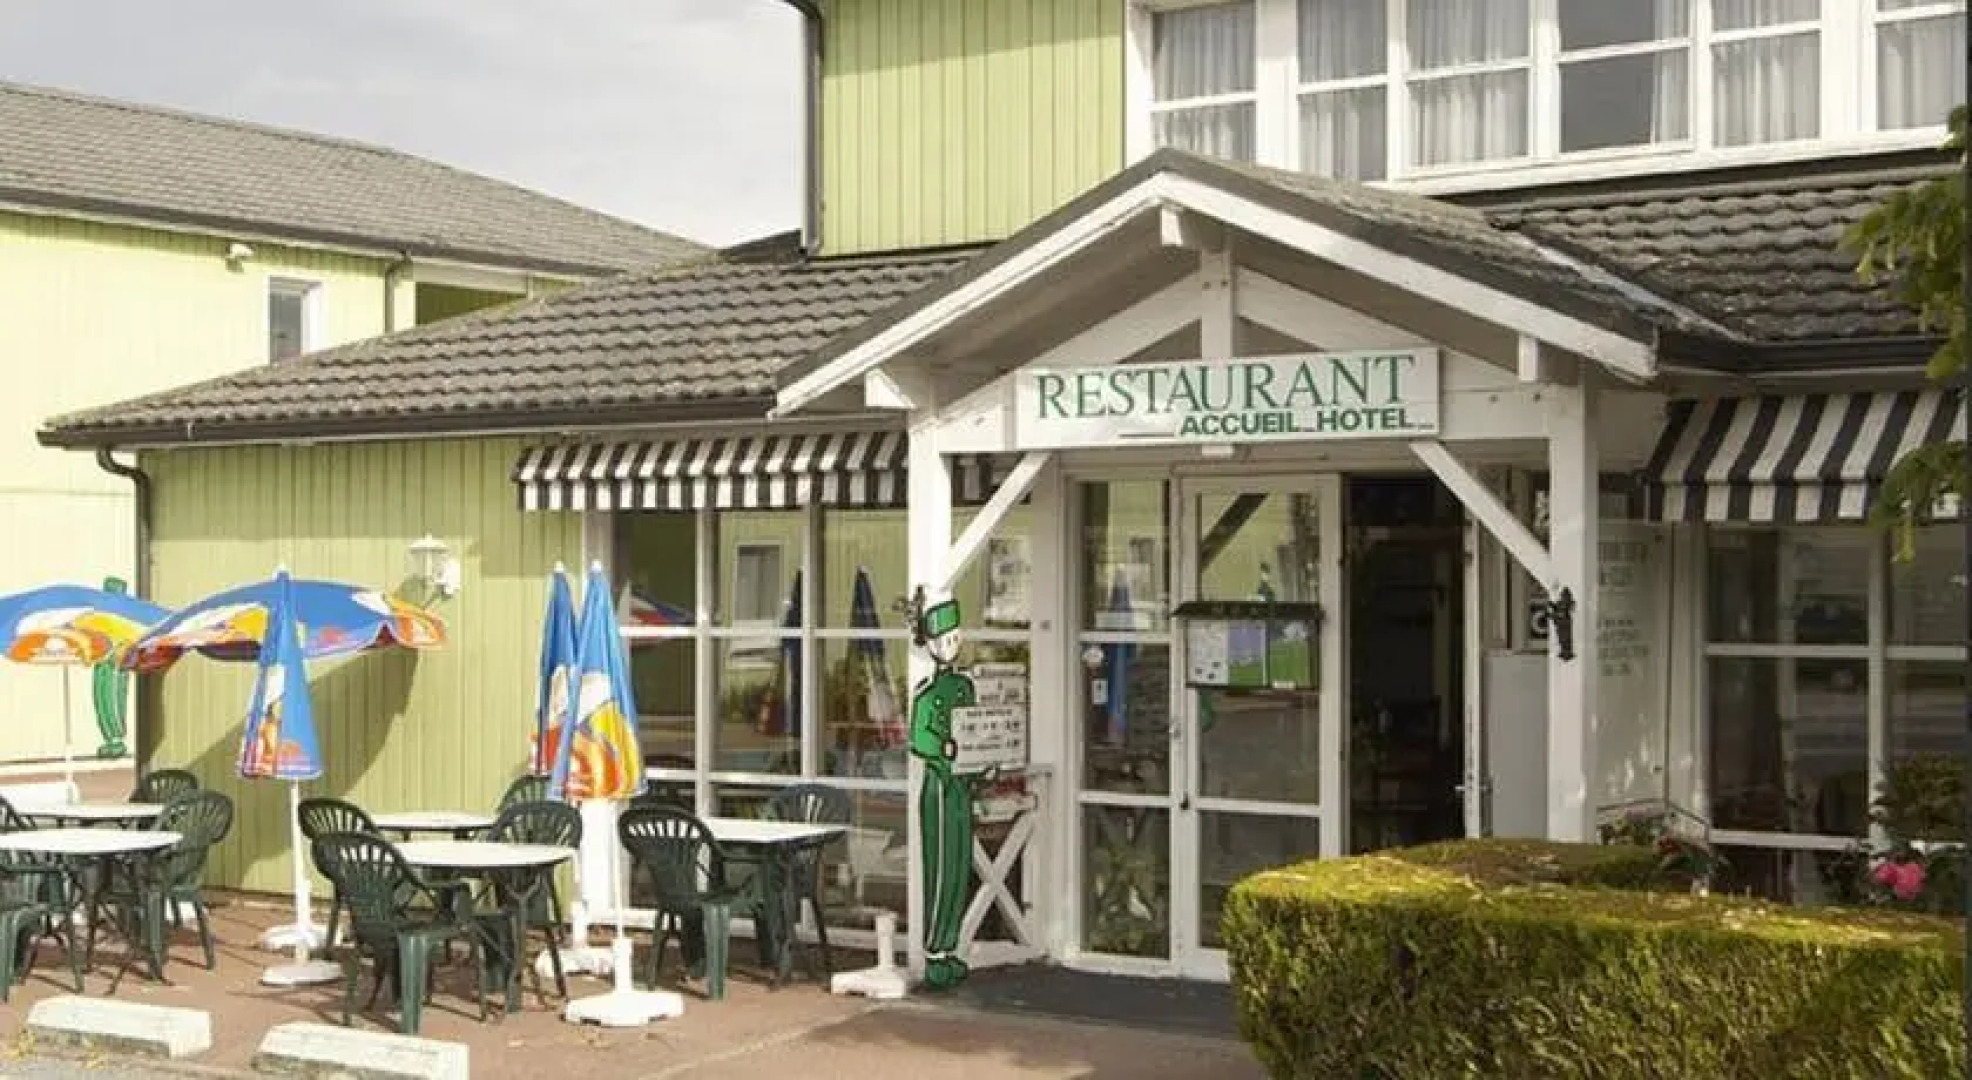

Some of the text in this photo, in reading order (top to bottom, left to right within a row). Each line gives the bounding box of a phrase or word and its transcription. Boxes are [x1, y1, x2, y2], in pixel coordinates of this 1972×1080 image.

[1034, 354, 1414, 418] RESTAURANT
[1181, 408, 1413, 435] ACCUEIL HOTEL
